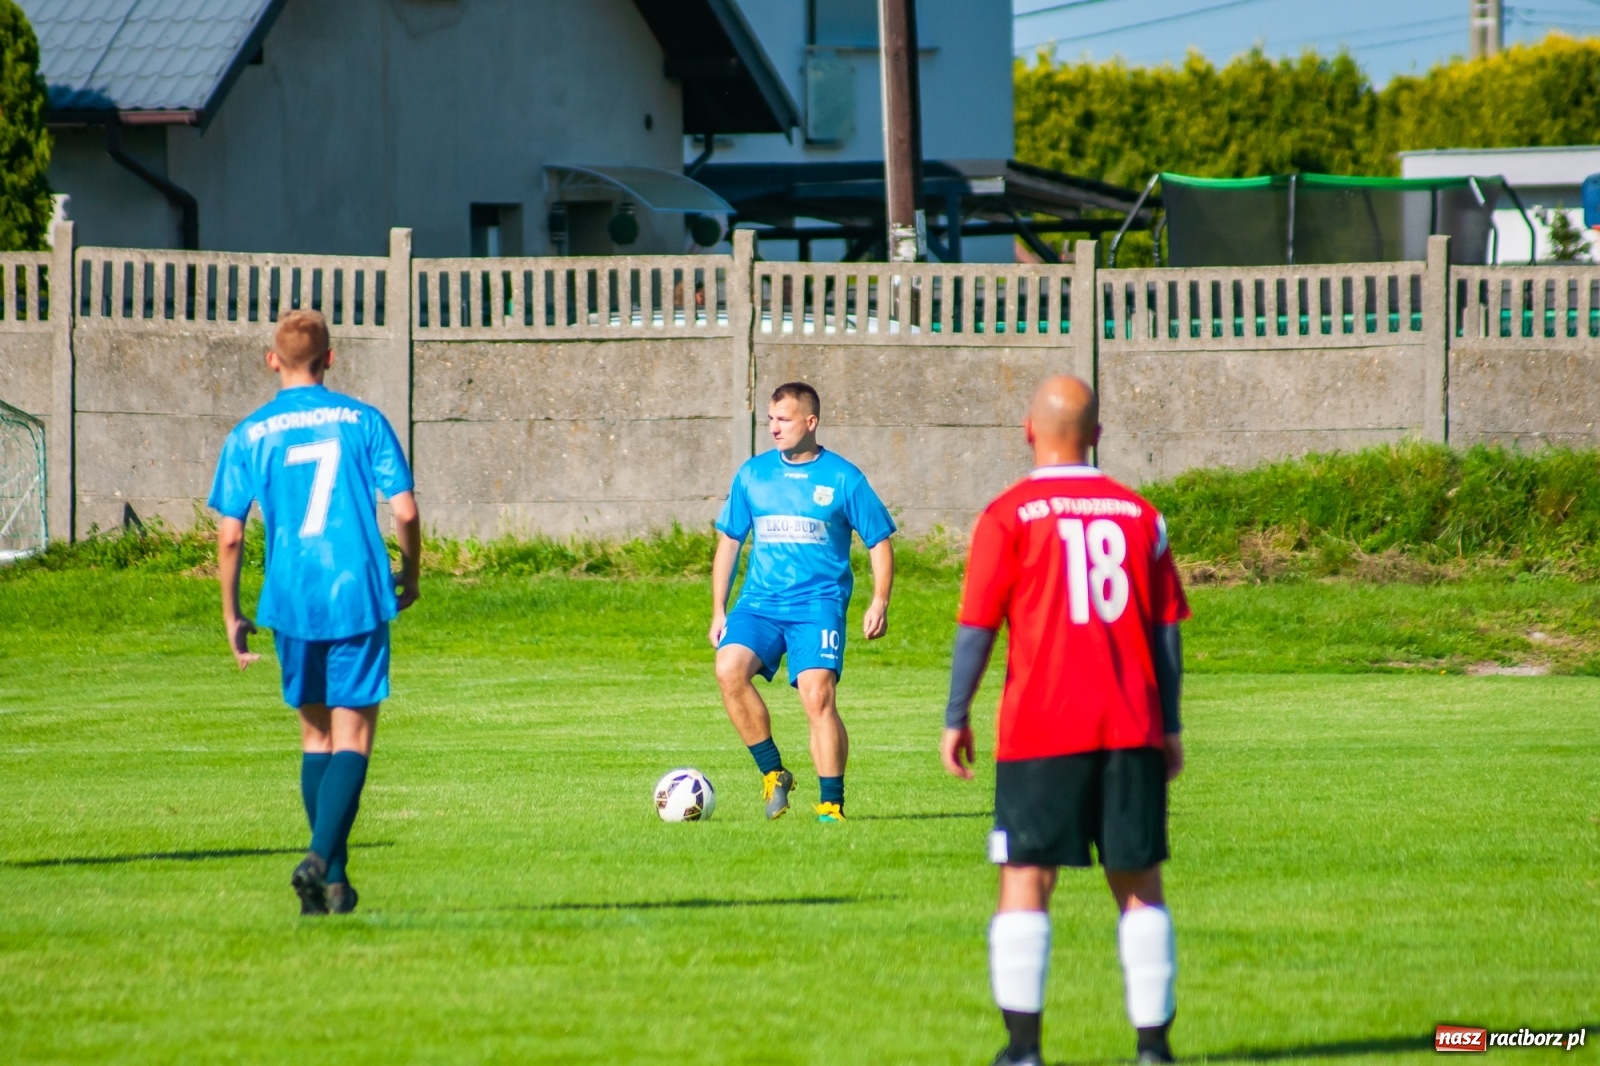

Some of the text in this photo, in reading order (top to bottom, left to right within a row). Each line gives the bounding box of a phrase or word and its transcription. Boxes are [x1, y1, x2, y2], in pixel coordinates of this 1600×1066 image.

[284, 437, 341, 538] 7
[1056, 518, 1129, 625] 18
[820, 628, 840, 651] 10
